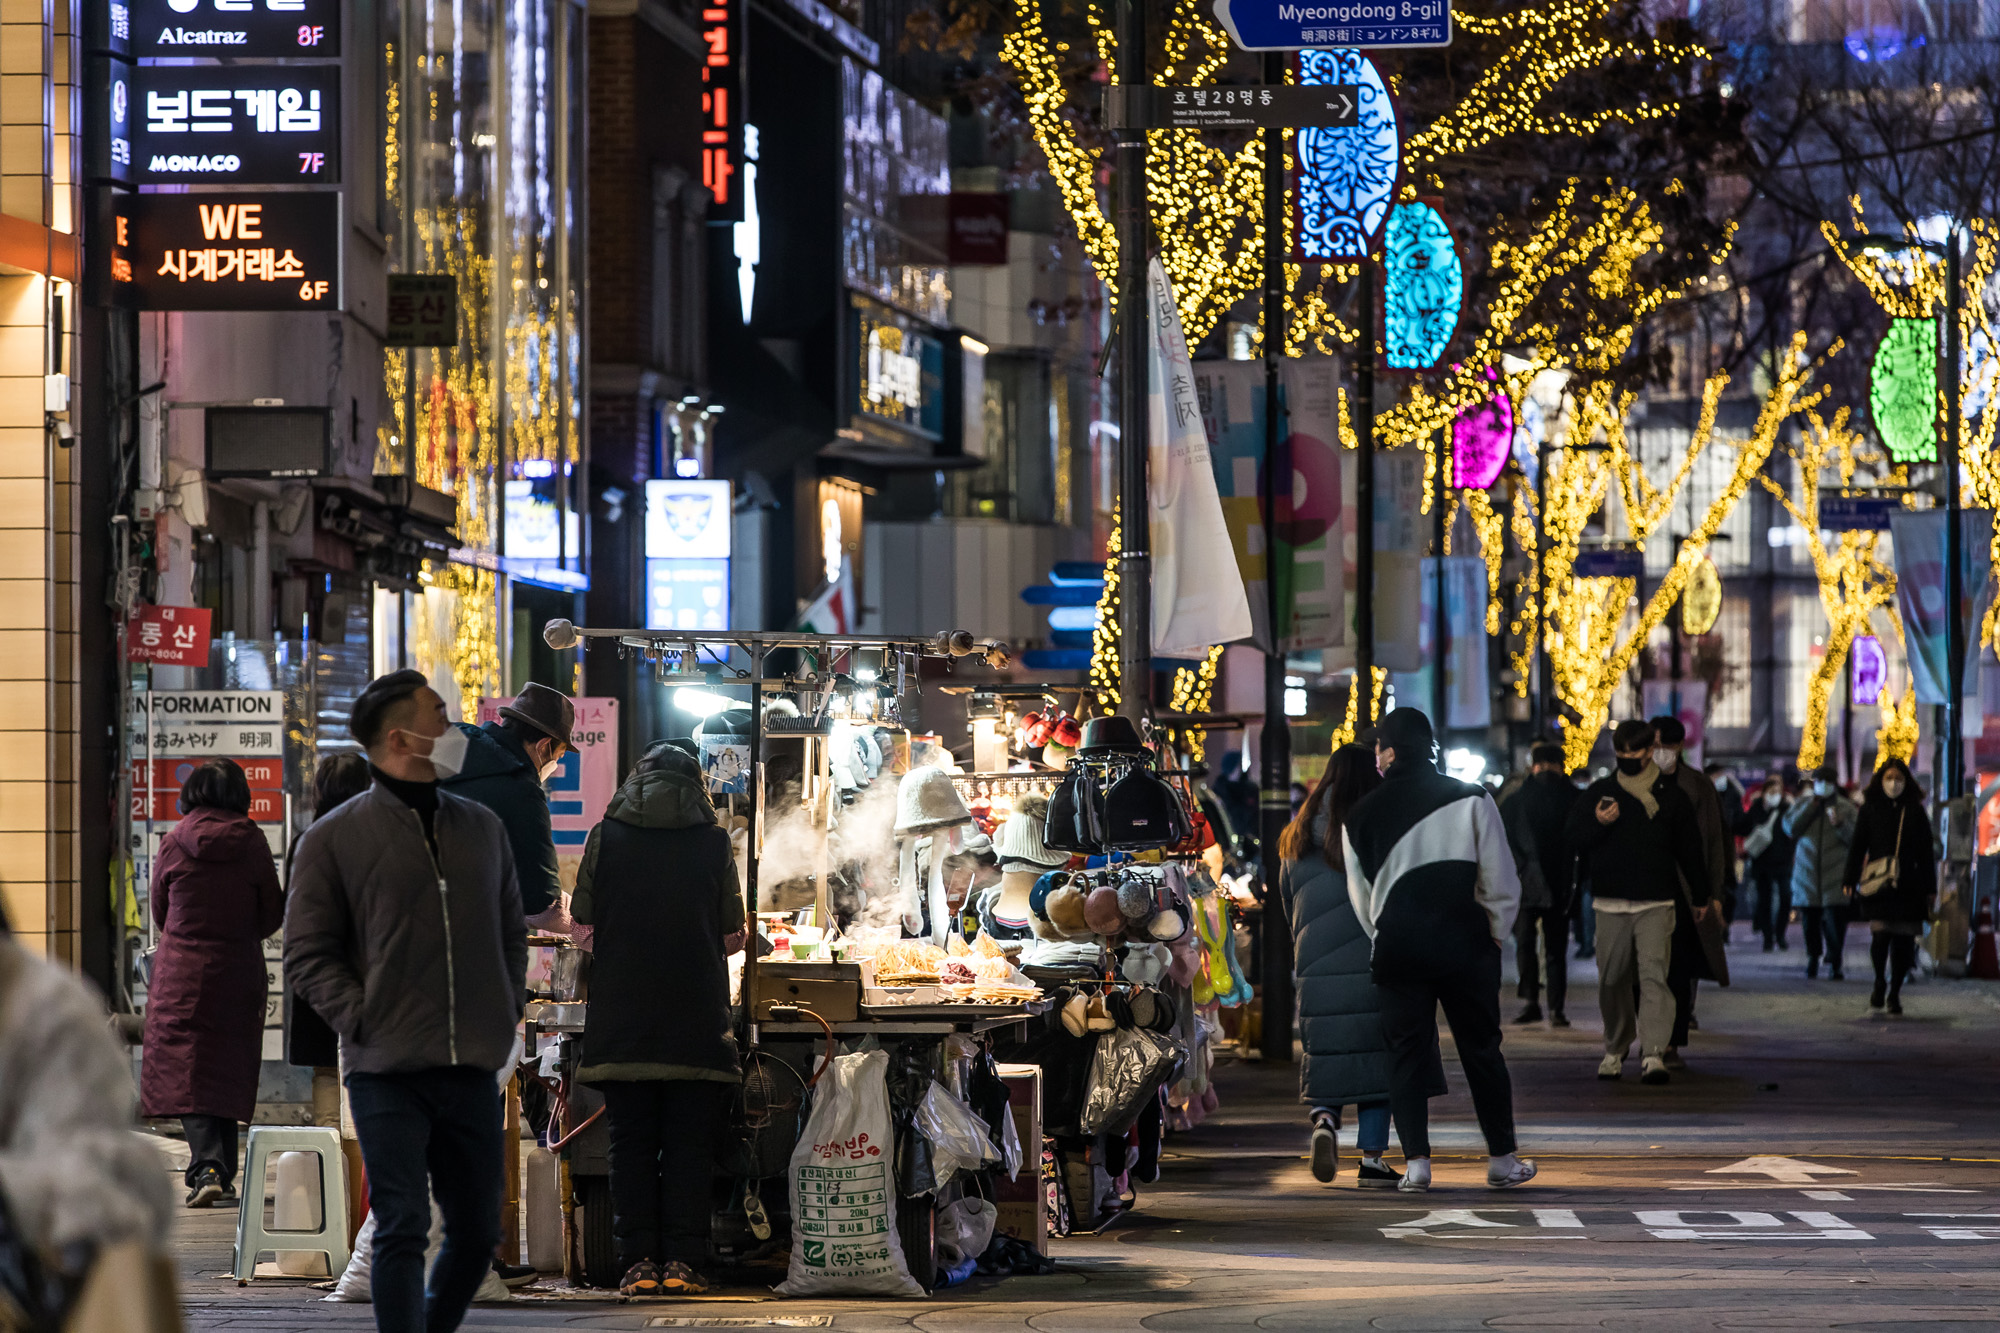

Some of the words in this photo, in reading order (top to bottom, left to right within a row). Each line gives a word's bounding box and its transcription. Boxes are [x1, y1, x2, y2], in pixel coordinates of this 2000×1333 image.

[1278, 3, 1396, 23] Myeongdong
[1401, 1, 1442, 21] 8-gil
[157, 27, 248, 45] Alcatraz
[298, 25, 324, 46] 8F
[1301, 29, 1350, 43] 明洞8街
[1356, 28, 1442, 41] ミョンドン8ギル
[147, 88, 321, 133] 보드게임
[148, 154, 241, 173] MONACO
[298, 152, 325, 174] 7F
[199, 203, 263, 241] WE
[156, 247, 305, 283] 시계거래소
[299, 280, 329, 301] 6F
[153, 731, 218, 749] おみやげ
[239, 731, 273, 748] 明洞
[849, 1208, 869, 1218] 20kg
